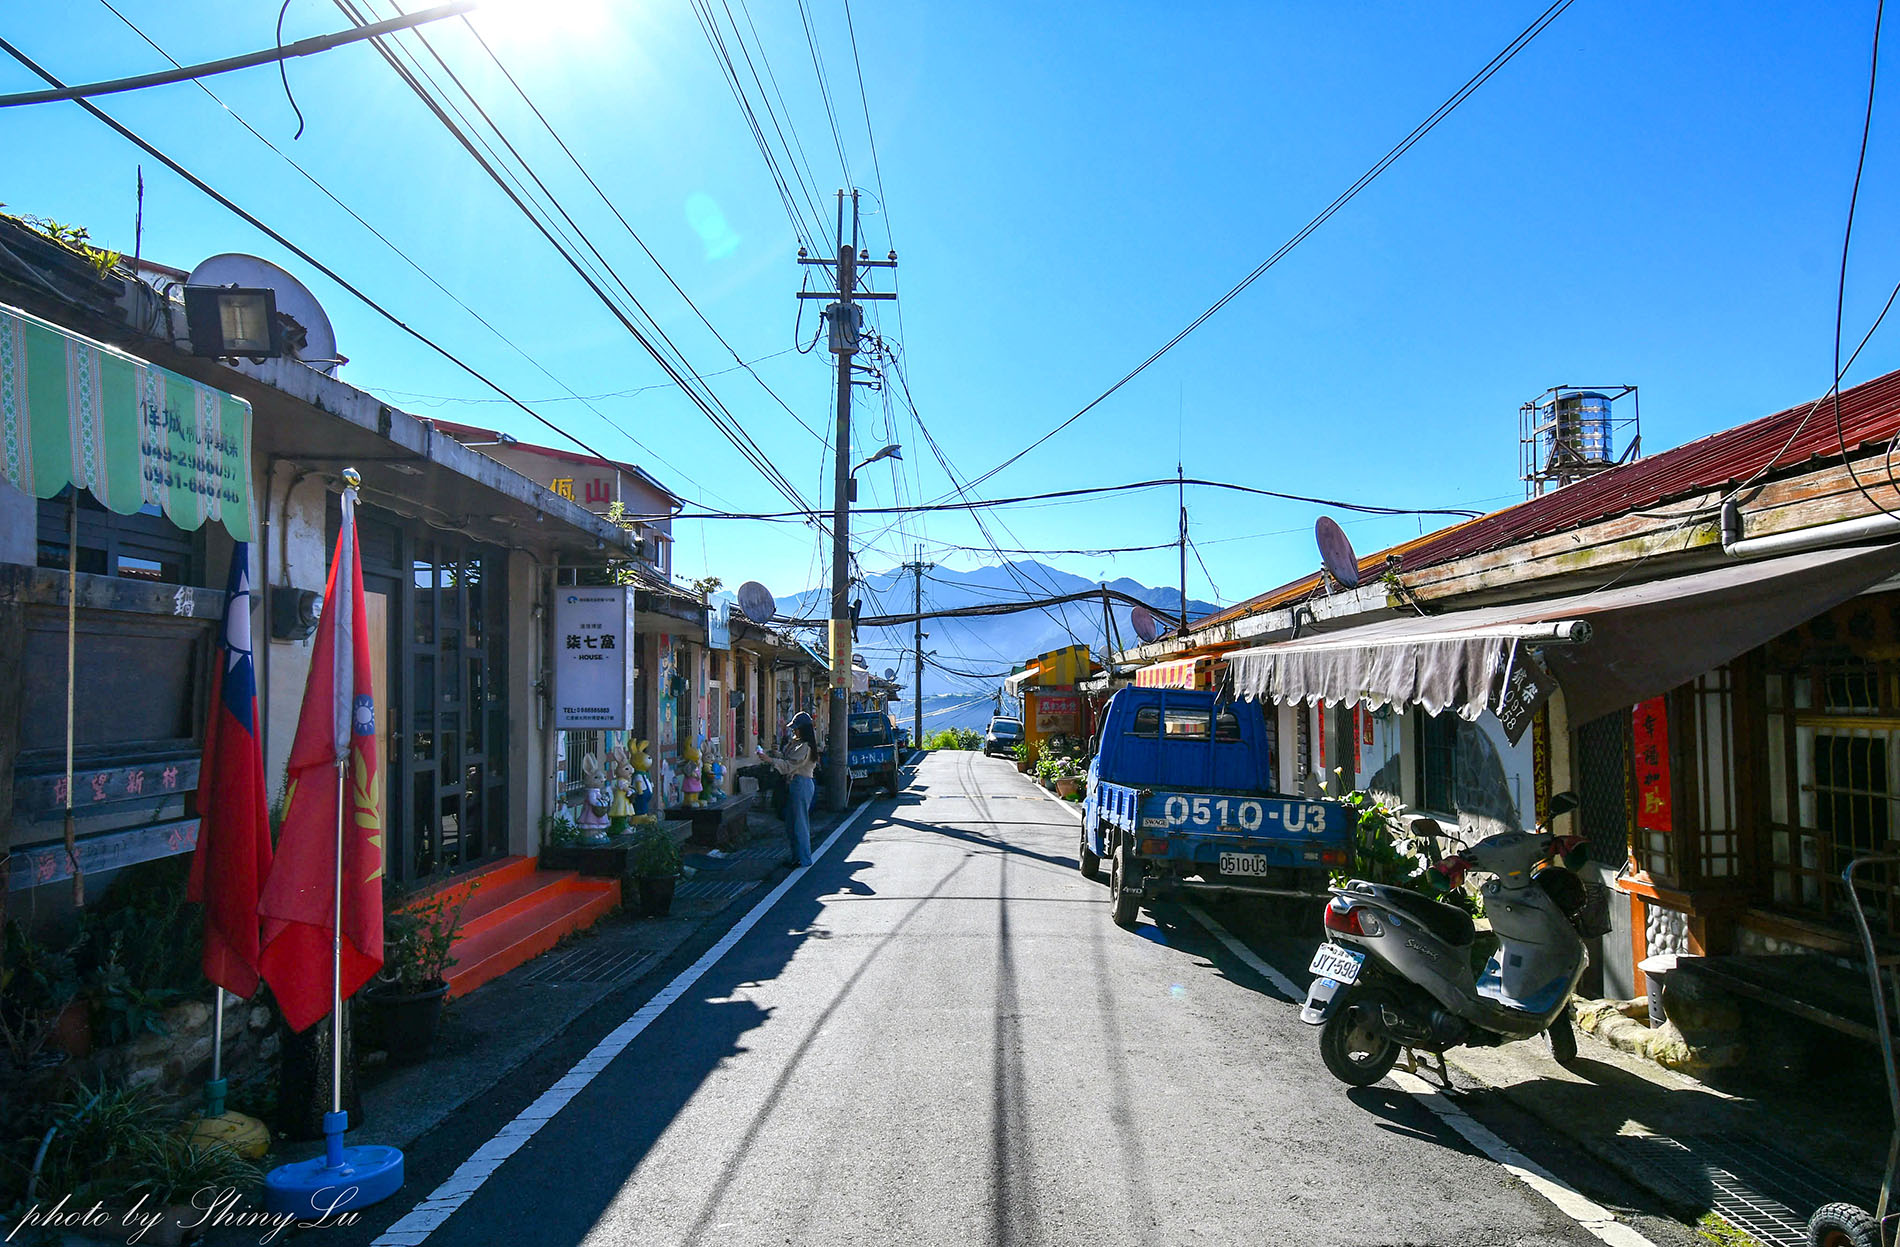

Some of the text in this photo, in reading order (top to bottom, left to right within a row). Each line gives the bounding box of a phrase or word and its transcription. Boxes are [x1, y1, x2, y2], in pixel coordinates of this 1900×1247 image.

[566, 635, 615, 649] 柒七窩
[1164, 796, 1326, 834] 0510-U3
[1312, 953, 1359, 980] JY7-598
